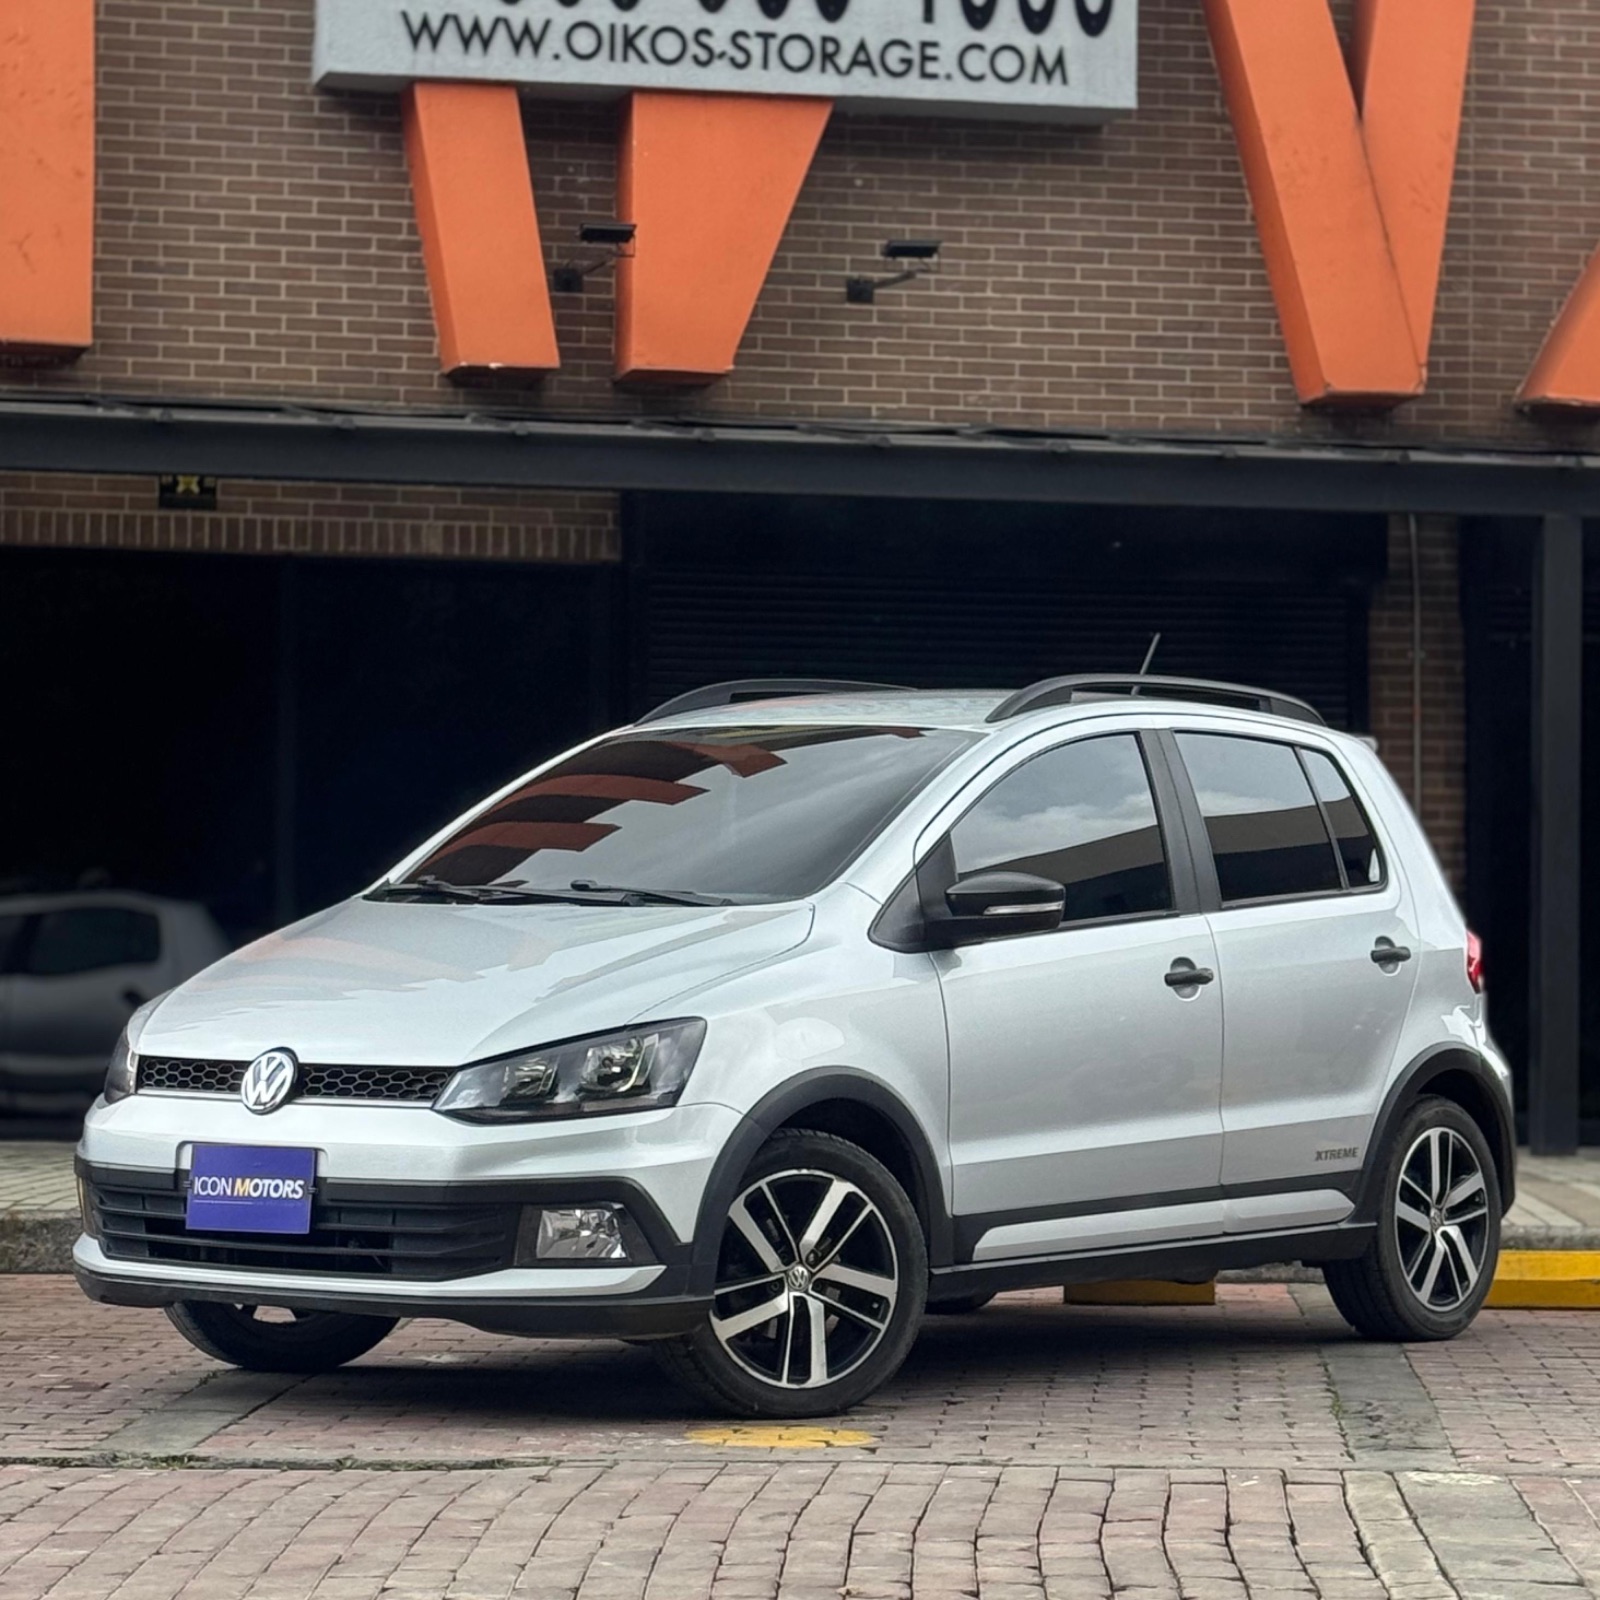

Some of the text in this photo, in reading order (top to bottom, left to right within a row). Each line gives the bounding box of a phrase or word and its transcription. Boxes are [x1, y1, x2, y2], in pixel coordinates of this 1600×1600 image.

[401, 10, 1068, 86] WWW.OIKOS-STORAGE.COM
[242, 1051, 295, 1111] VW
[1315, 1147, 1359, 1161] XTREME
[194, 1176, 304, 1199] ICON MOTORS
